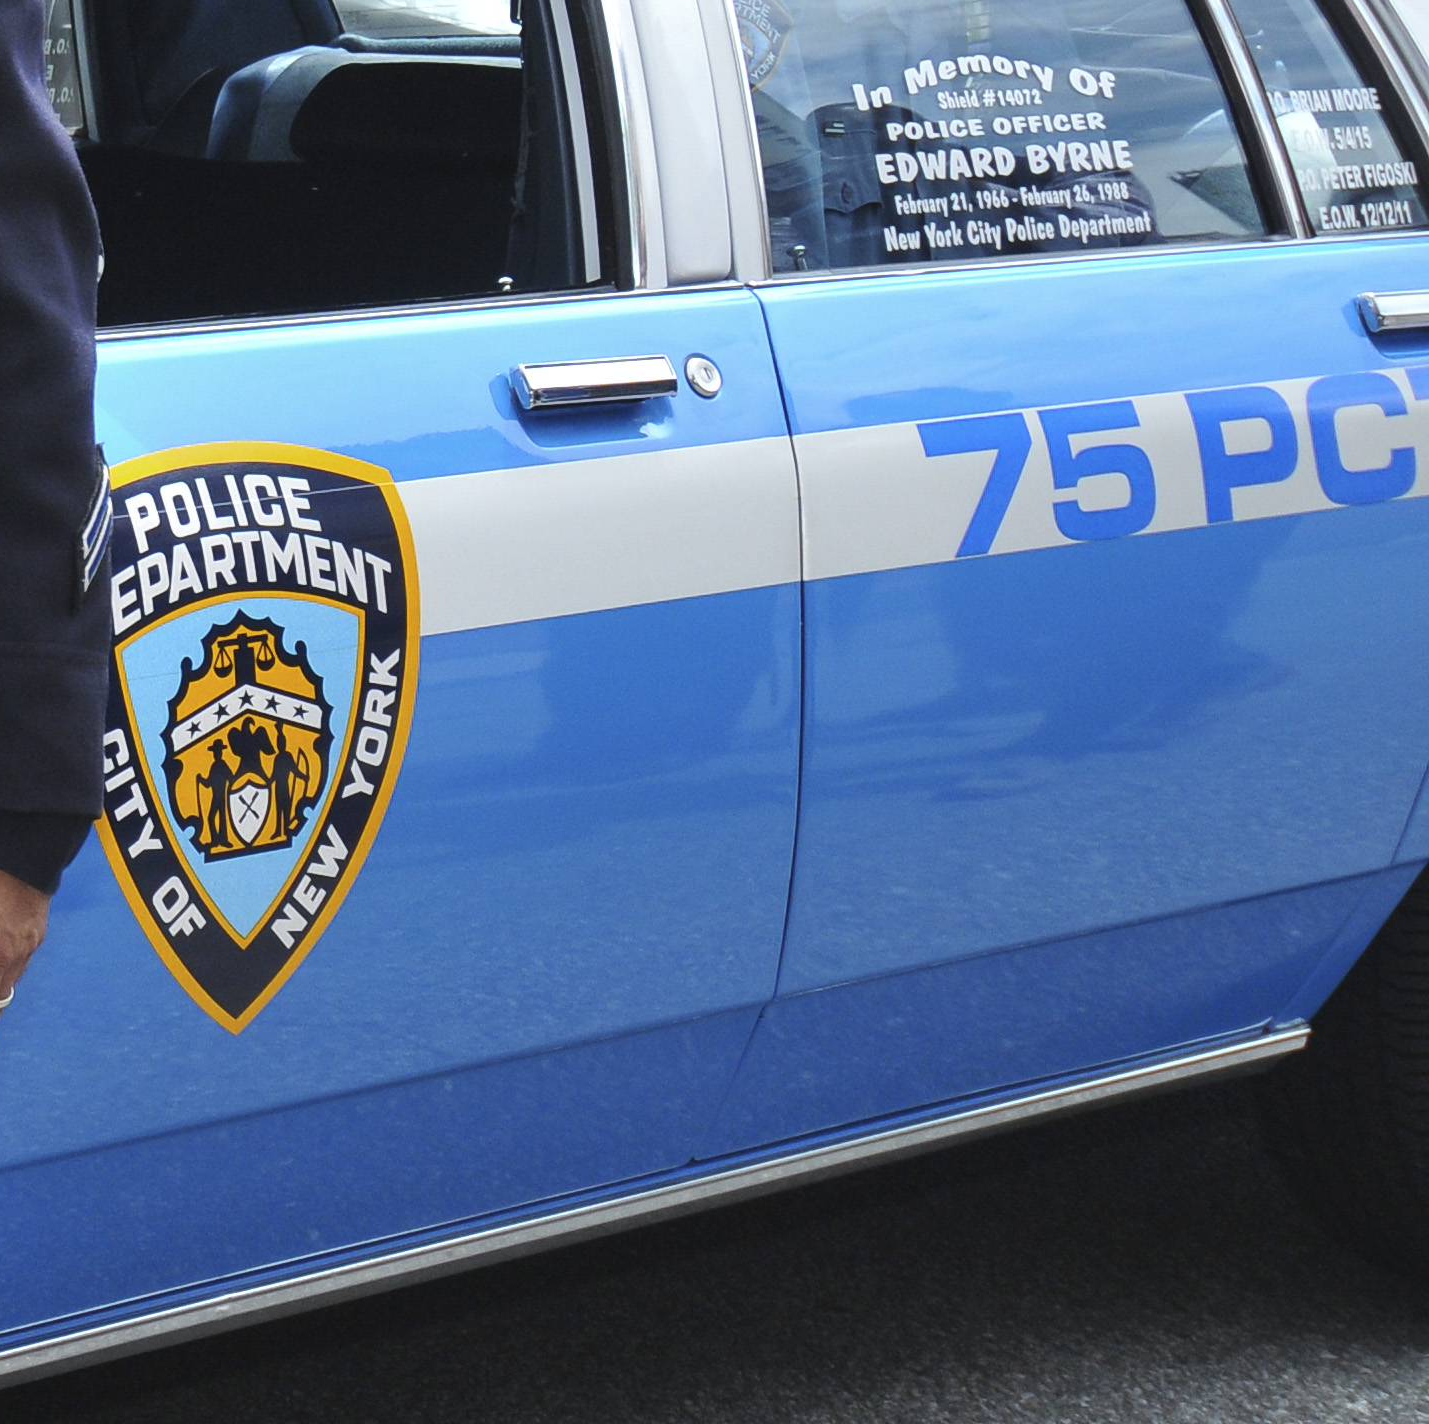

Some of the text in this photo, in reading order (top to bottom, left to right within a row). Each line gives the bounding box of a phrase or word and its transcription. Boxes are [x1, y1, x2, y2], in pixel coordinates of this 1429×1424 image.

[734, 2, 781, 44] RTMENT
[852, 54, 1116, 111] In Memory Of
[937, 87, 1042, 110] Shield #14072
[1289, 89, 1333, 112] BRIAN
[1331, 87, 1381, 111] MOORE
[886, 112, 1106, 141] POLICE OFFICER
[1333, 126, 1372, 150] 5/4/15
[875, 140, 1134, 184] EDWARD BYRNE
[1323, 164, 1365, 190] PETER
[1363, 161, 1419, 188] FIGOSKI
[894, 192, 949, 218] February
[951, 190, 973, 212] 21,
[976, 189, 1009, 210] 1966
[1020, 185, 1071, 209] February
[1073, 183, 1094, 204] 26,
[1097, 182, 1129, 201] 1988
[1319, 200, 1412, 230] E.O.W. 12/12/11
[883, 211, 1152, 252] New York City Police Department
[916, 400, 1156, 559] 75
[125, 473, 322, 555] POLICE
[111, 531, 392, 636] EPARTMENT
[270, 647, 401, 950] NEW YORK
[103, 727, 208, 938] CITY OF
